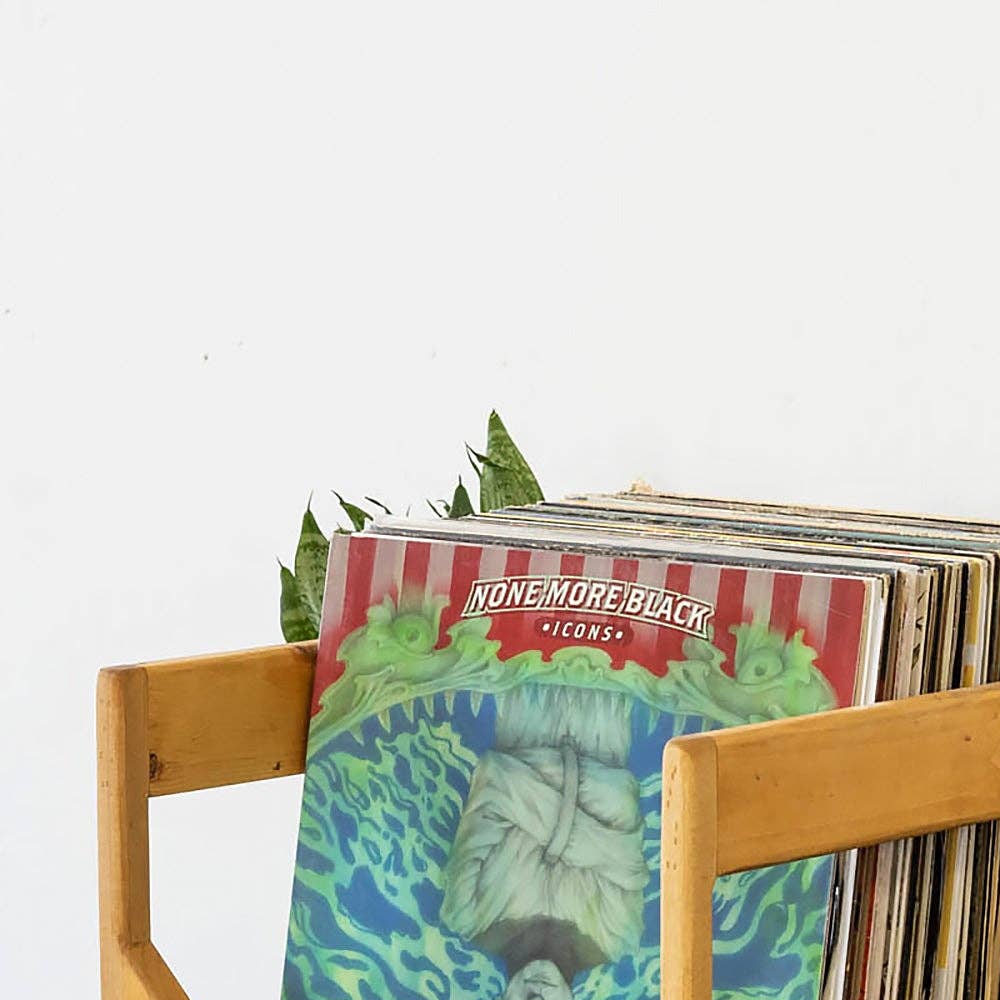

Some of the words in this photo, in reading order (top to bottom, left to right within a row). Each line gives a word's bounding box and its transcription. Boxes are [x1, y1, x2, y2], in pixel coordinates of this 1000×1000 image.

[470, 581, 541, 611] NONE
[546, 580, 625, 611] MORE
[627, 589, 708, 632] BLACK
[551, 620, 613, 642] ICONS
